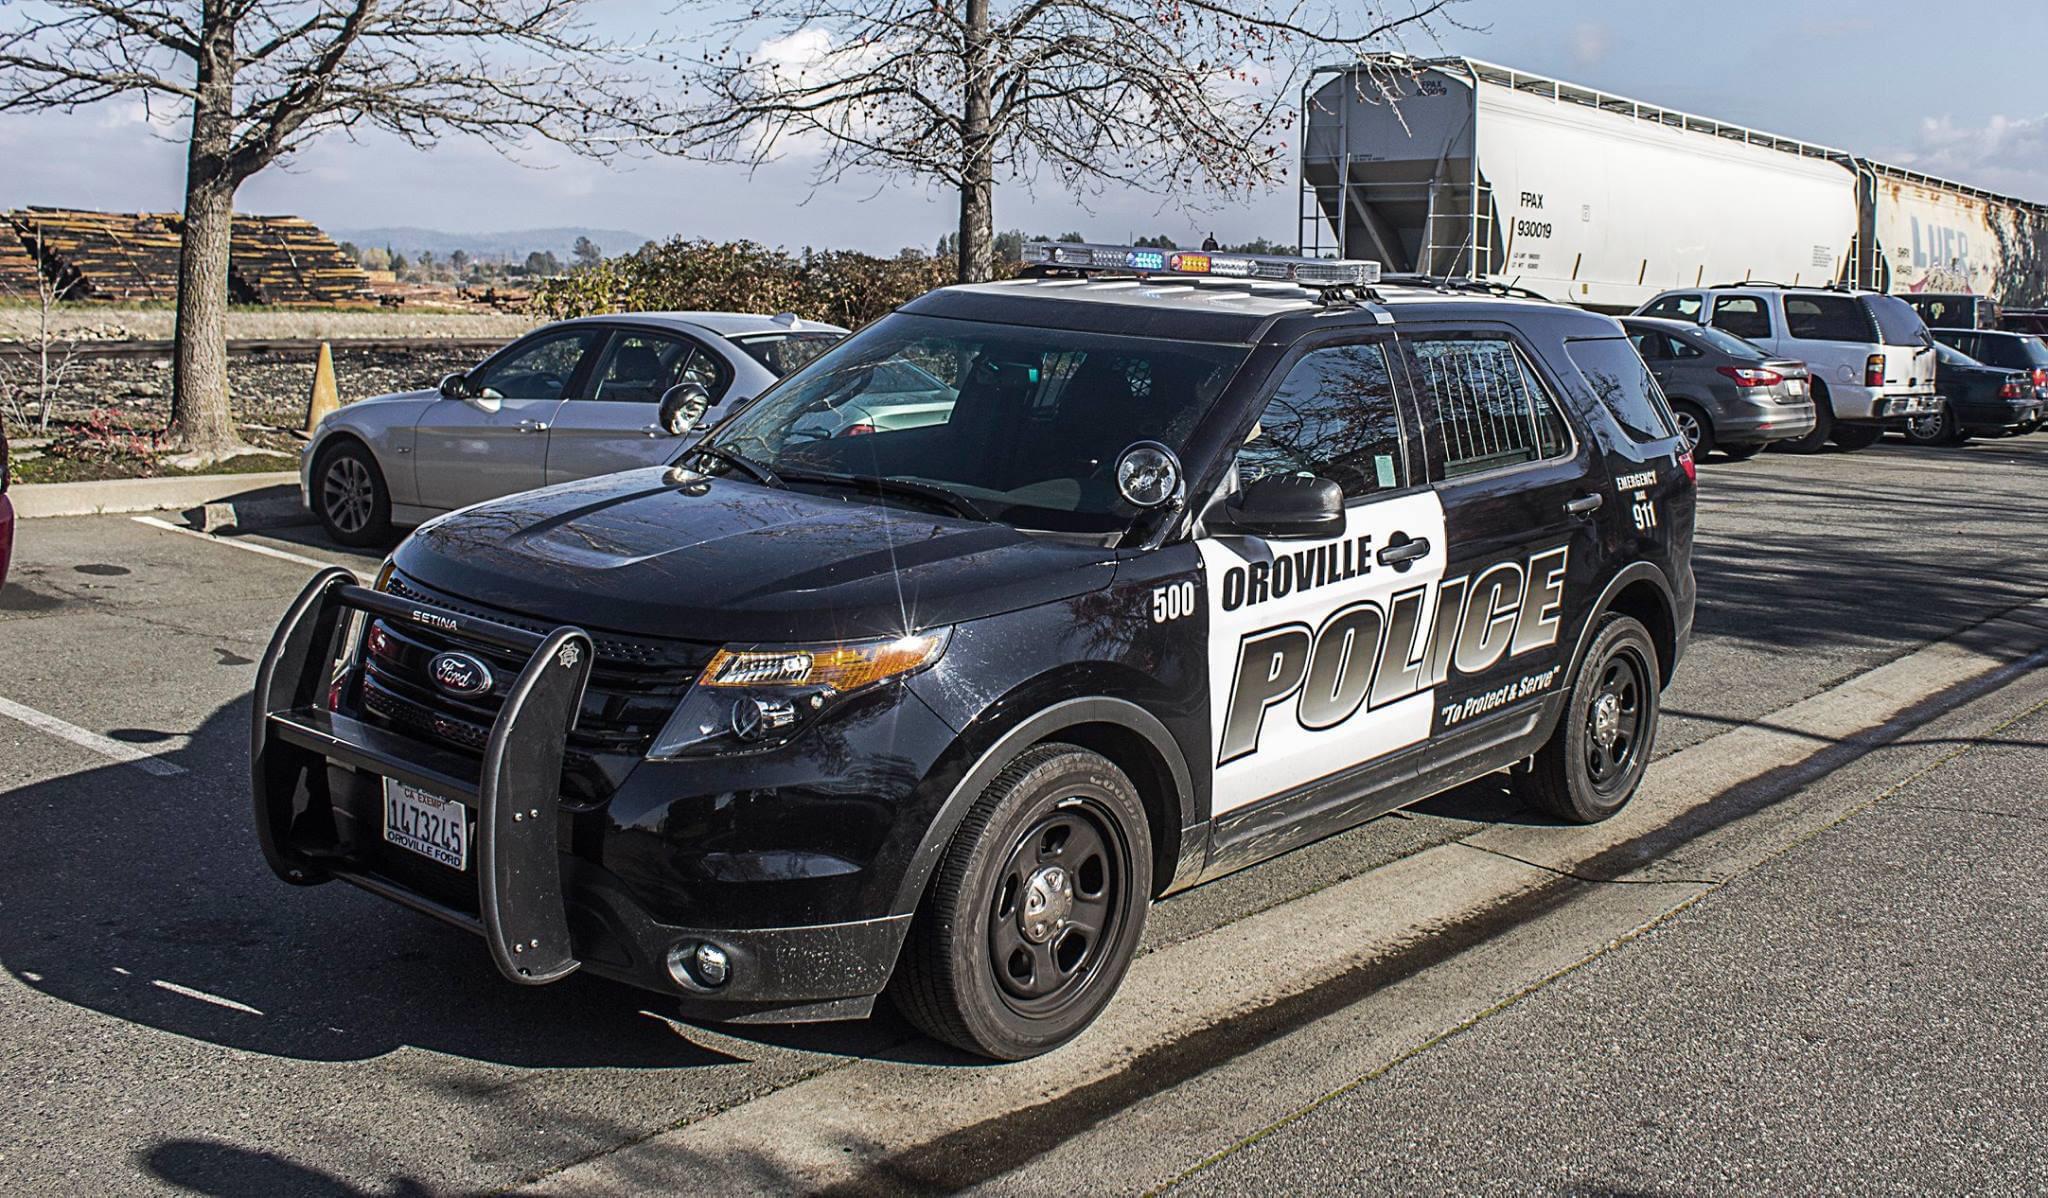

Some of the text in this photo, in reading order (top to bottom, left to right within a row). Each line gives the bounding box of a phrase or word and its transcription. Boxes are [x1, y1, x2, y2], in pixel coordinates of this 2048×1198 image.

[1520, 191, 1543, 209] FPAX
[1517, 220, 1552, 239] 930019
[1615, 470, 1657, 491] EMERGENCY
[1632, 500, 1656, 530] 911
[1222, 534, 1372, 612] OROVILLE
[1153, 581, 1194, 624] 500
[412, 610, 458, 631] SETINA
[1215, 545, 1569, 769] POLICE
[437, 658, 473, 687] Ford
[1461, 684, 1510, 720] Protect
[1507, 683, 1518, 702] &
[404, 787, 415, 800] CA
[417, 793, 447, 811] EXEMPT
[389, 800, 461, 856] 1473245
[387, 831, 461, 867] OROVILLE FORD
